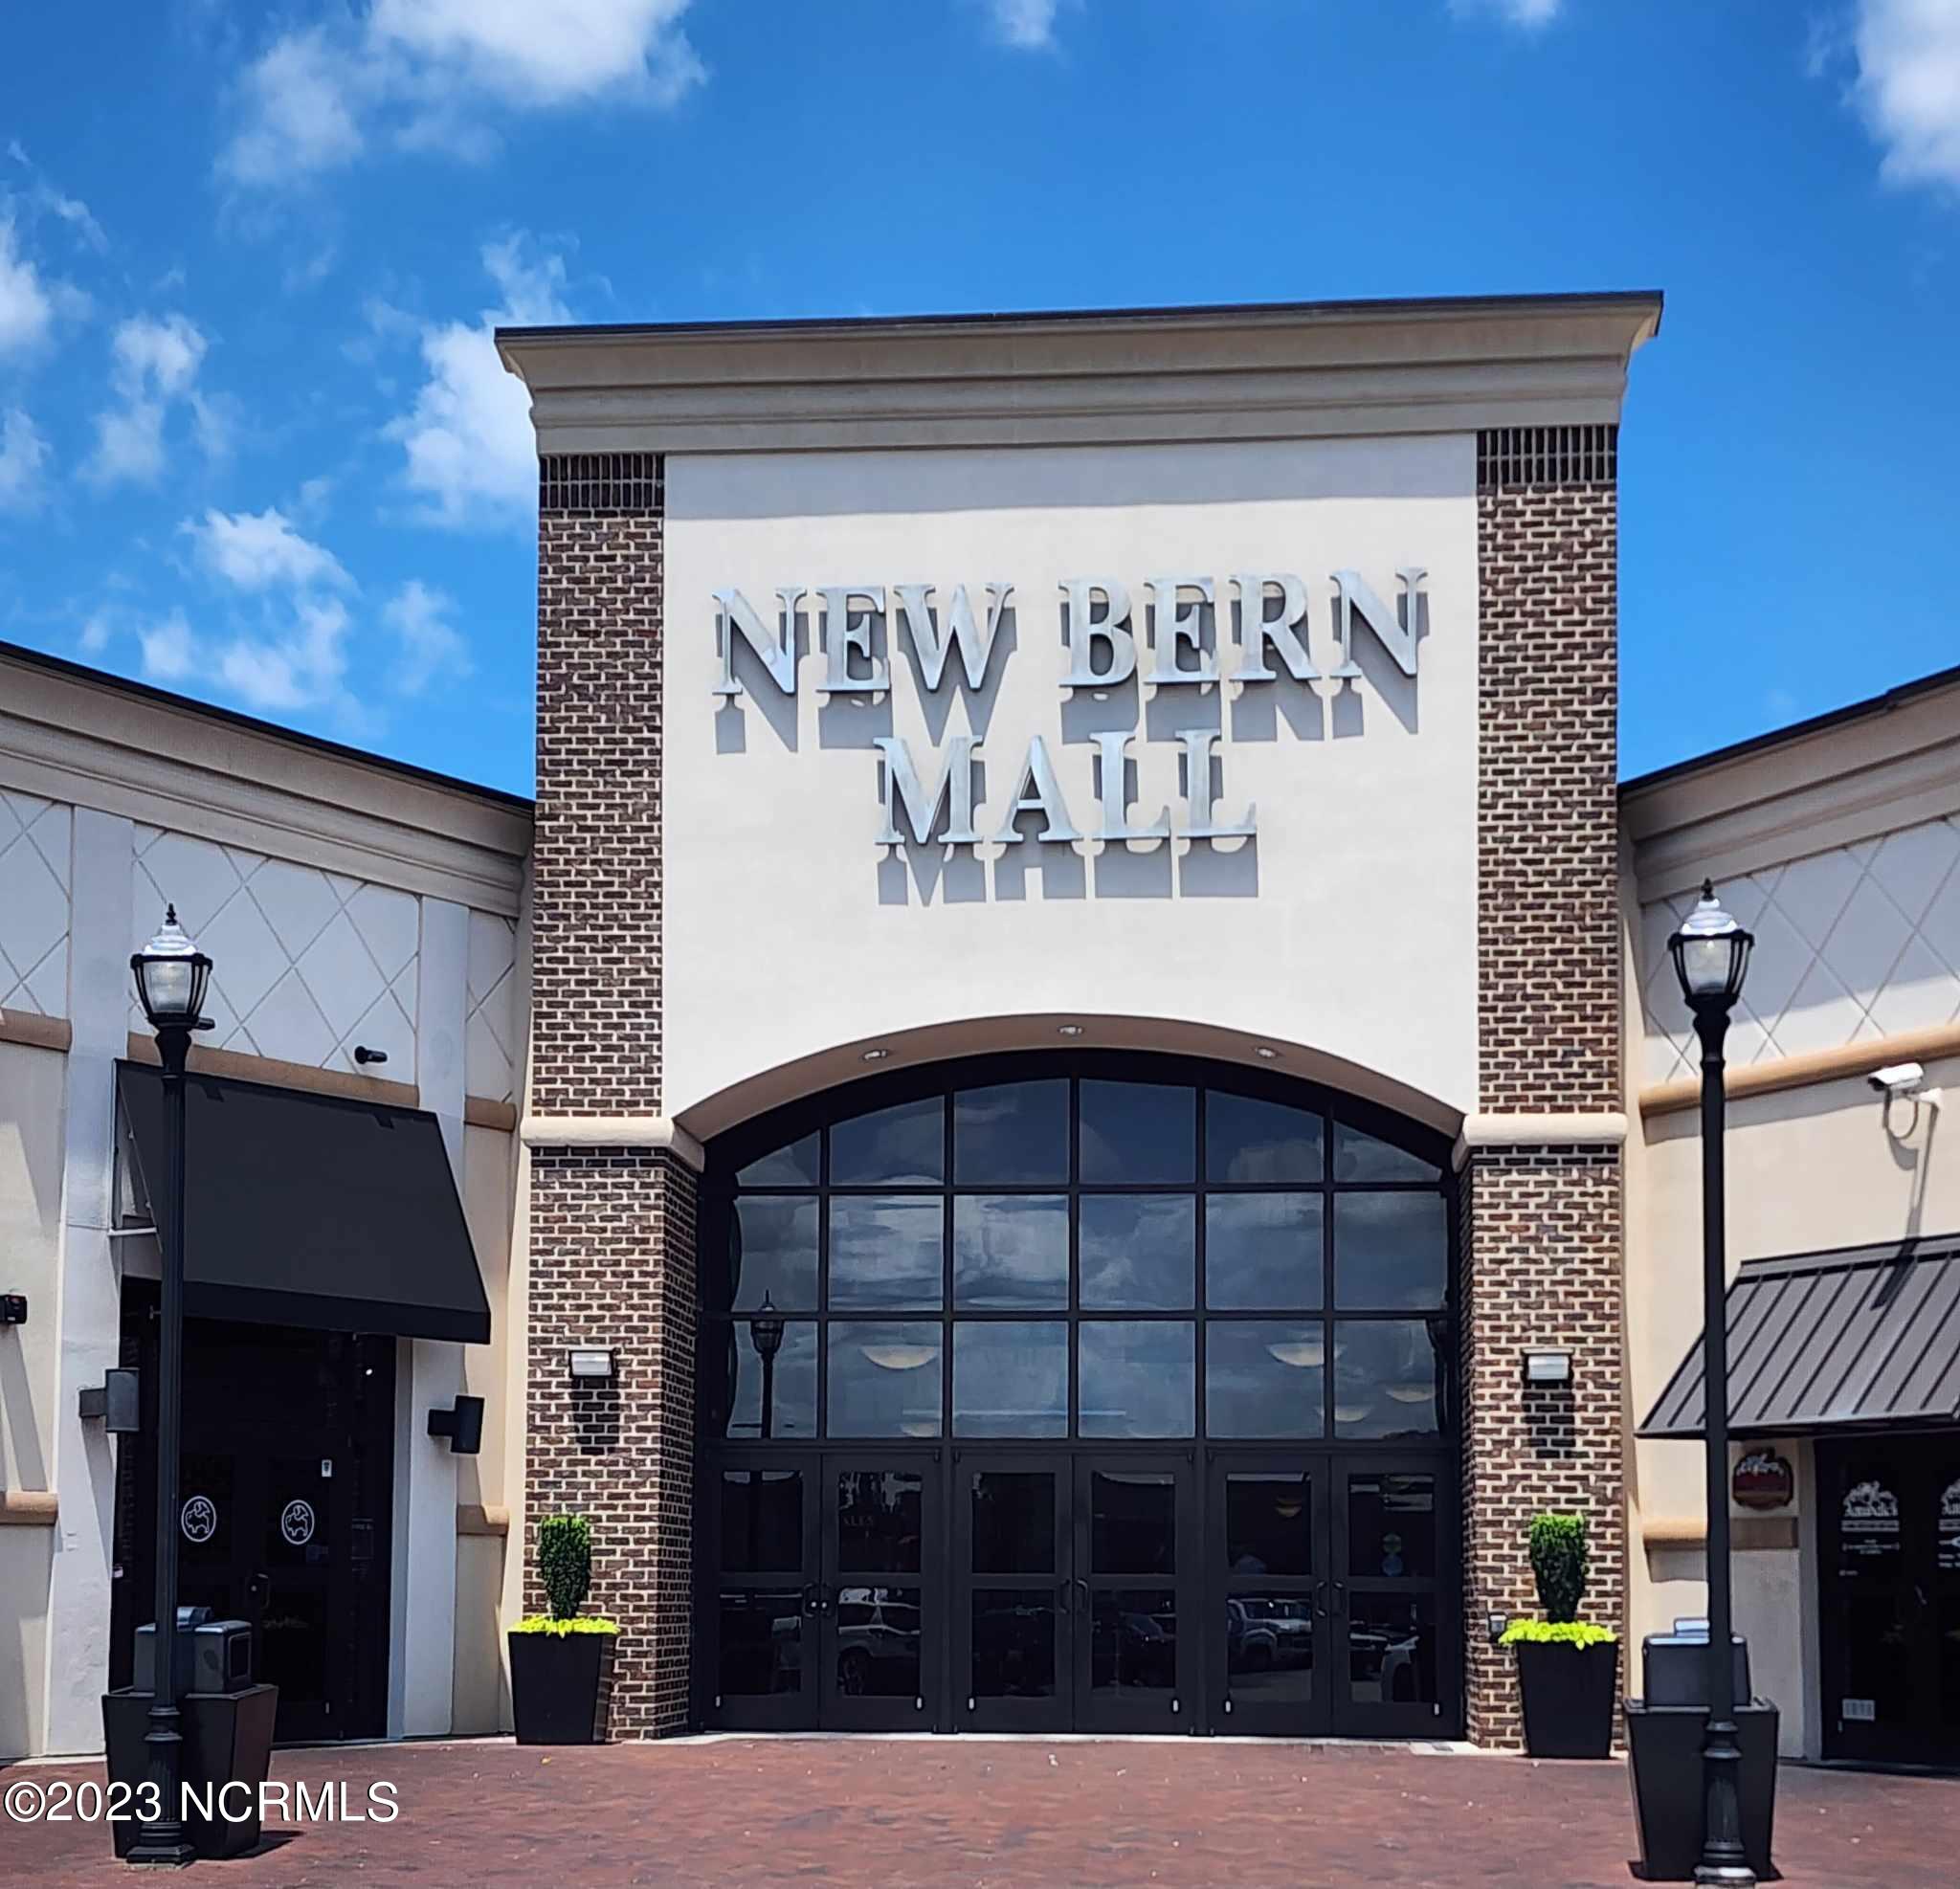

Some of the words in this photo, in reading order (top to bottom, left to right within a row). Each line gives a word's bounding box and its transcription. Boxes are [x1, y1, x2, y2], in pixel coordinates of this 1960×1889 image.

[712, 582, 1015, 695] NEW
[1058, 567, 1429, 689] BERN
[873, 729, 1258, 844] MALL
